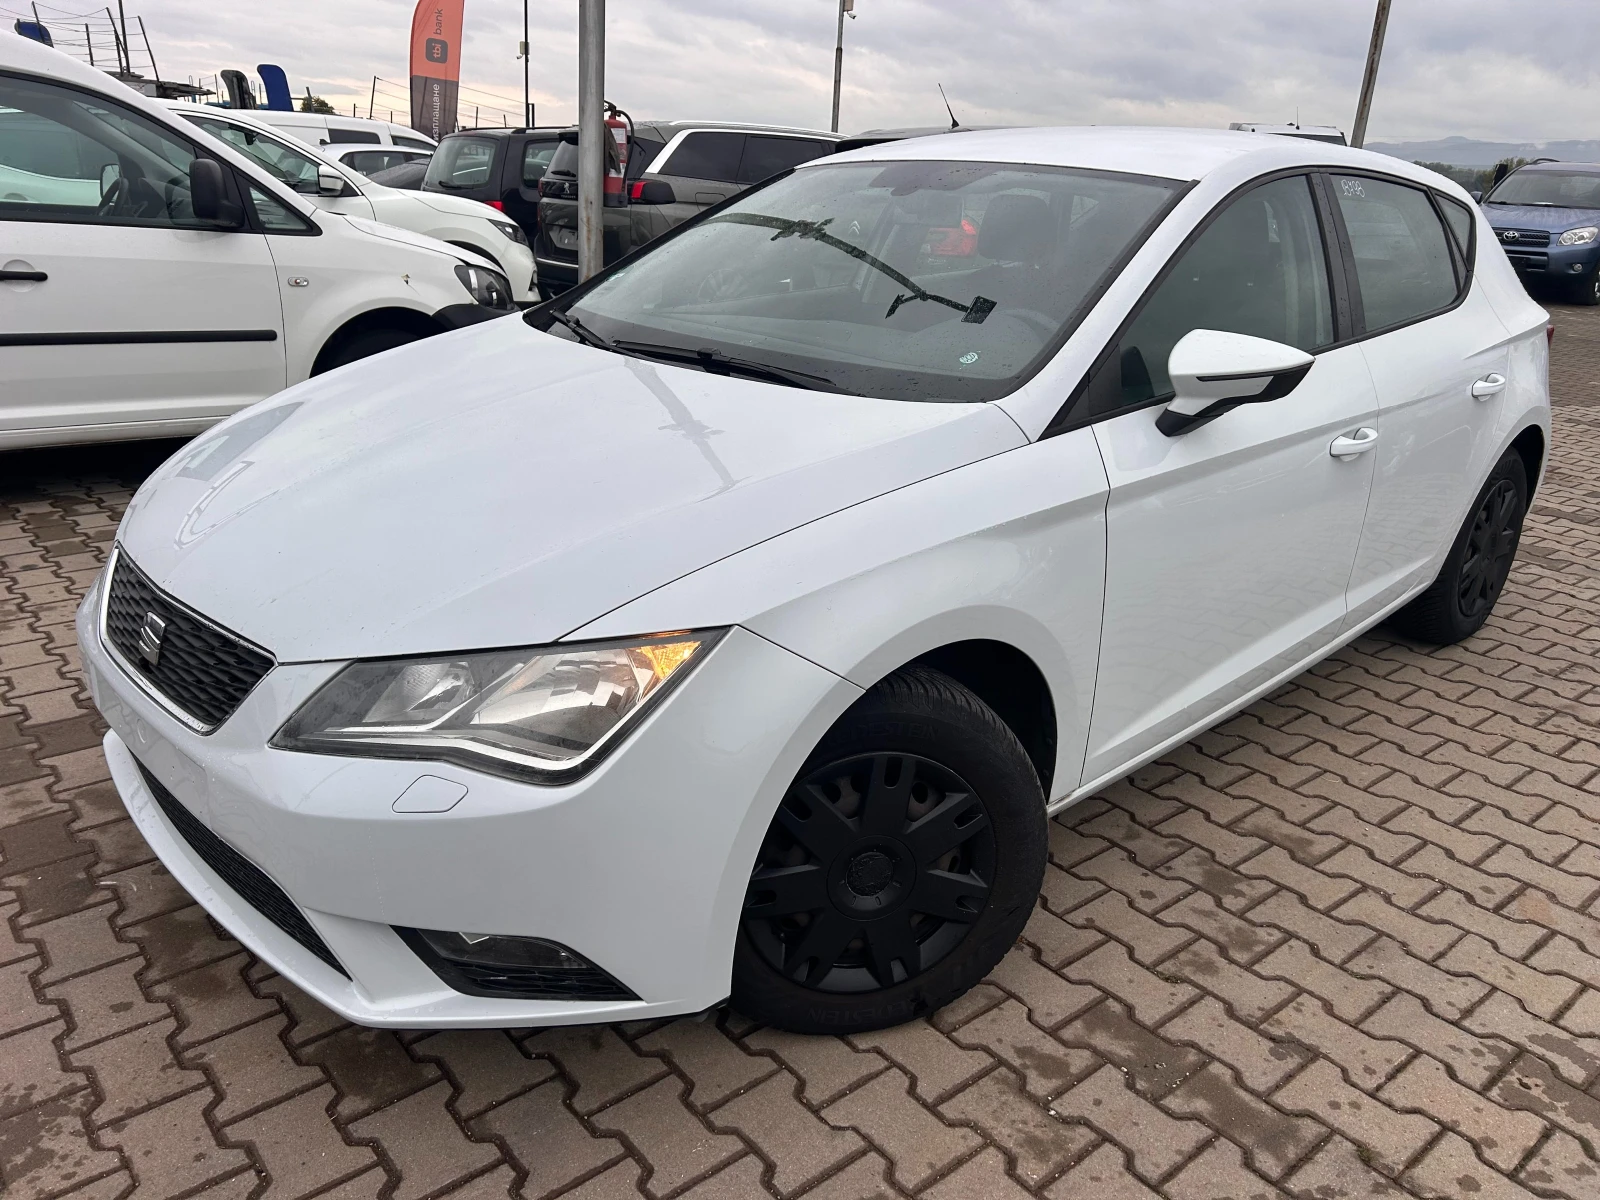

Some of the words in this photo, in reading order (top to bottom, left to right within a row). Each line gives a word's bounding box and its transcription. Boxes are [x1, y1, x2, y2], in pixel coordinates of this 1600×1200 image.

[433, 8, 443, 35] bank
[432, 43, 441, 58] tbi
[432, 83, 440, 140] изплащане
